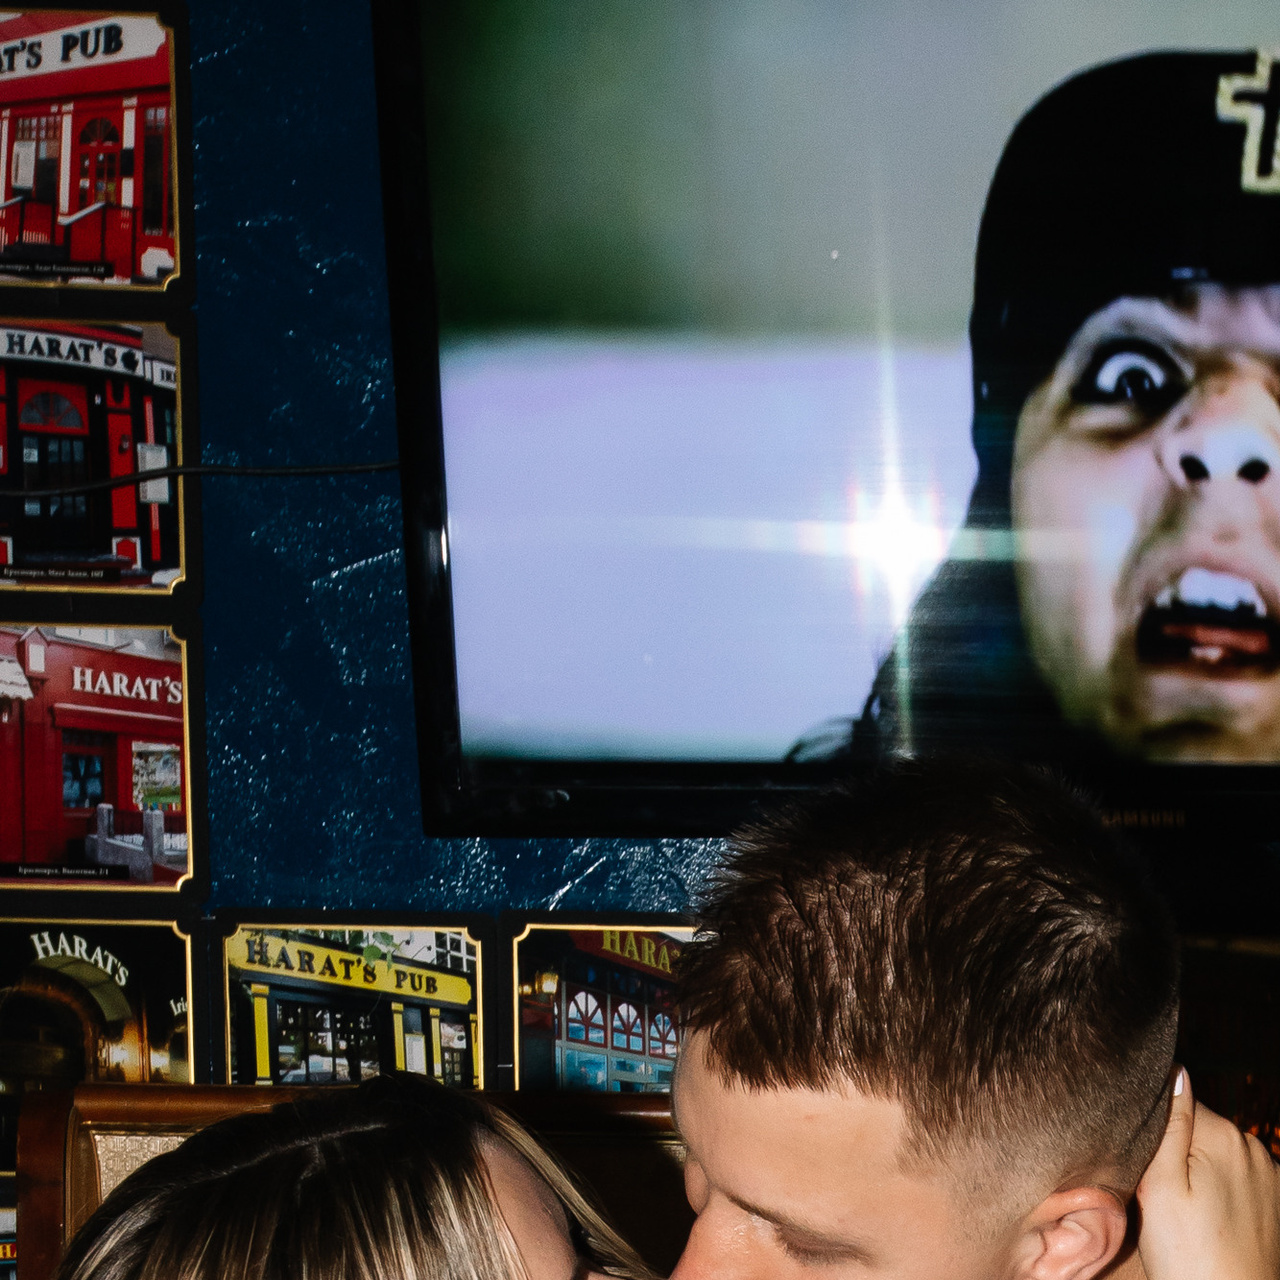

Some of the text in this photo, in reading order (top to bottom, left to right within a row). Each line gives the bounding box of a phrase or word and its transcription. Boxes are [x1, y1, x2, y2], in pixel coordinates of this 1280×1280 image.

[0, 23, 123, 73] T'S PUB
[6, 332, 118, 367] HARAT'S
[72, 666, 183, 704] HARAT'S
[30, 931, 129, 987] HARAT'S
[246, 938, 438, 995] HARAT'S PUB
